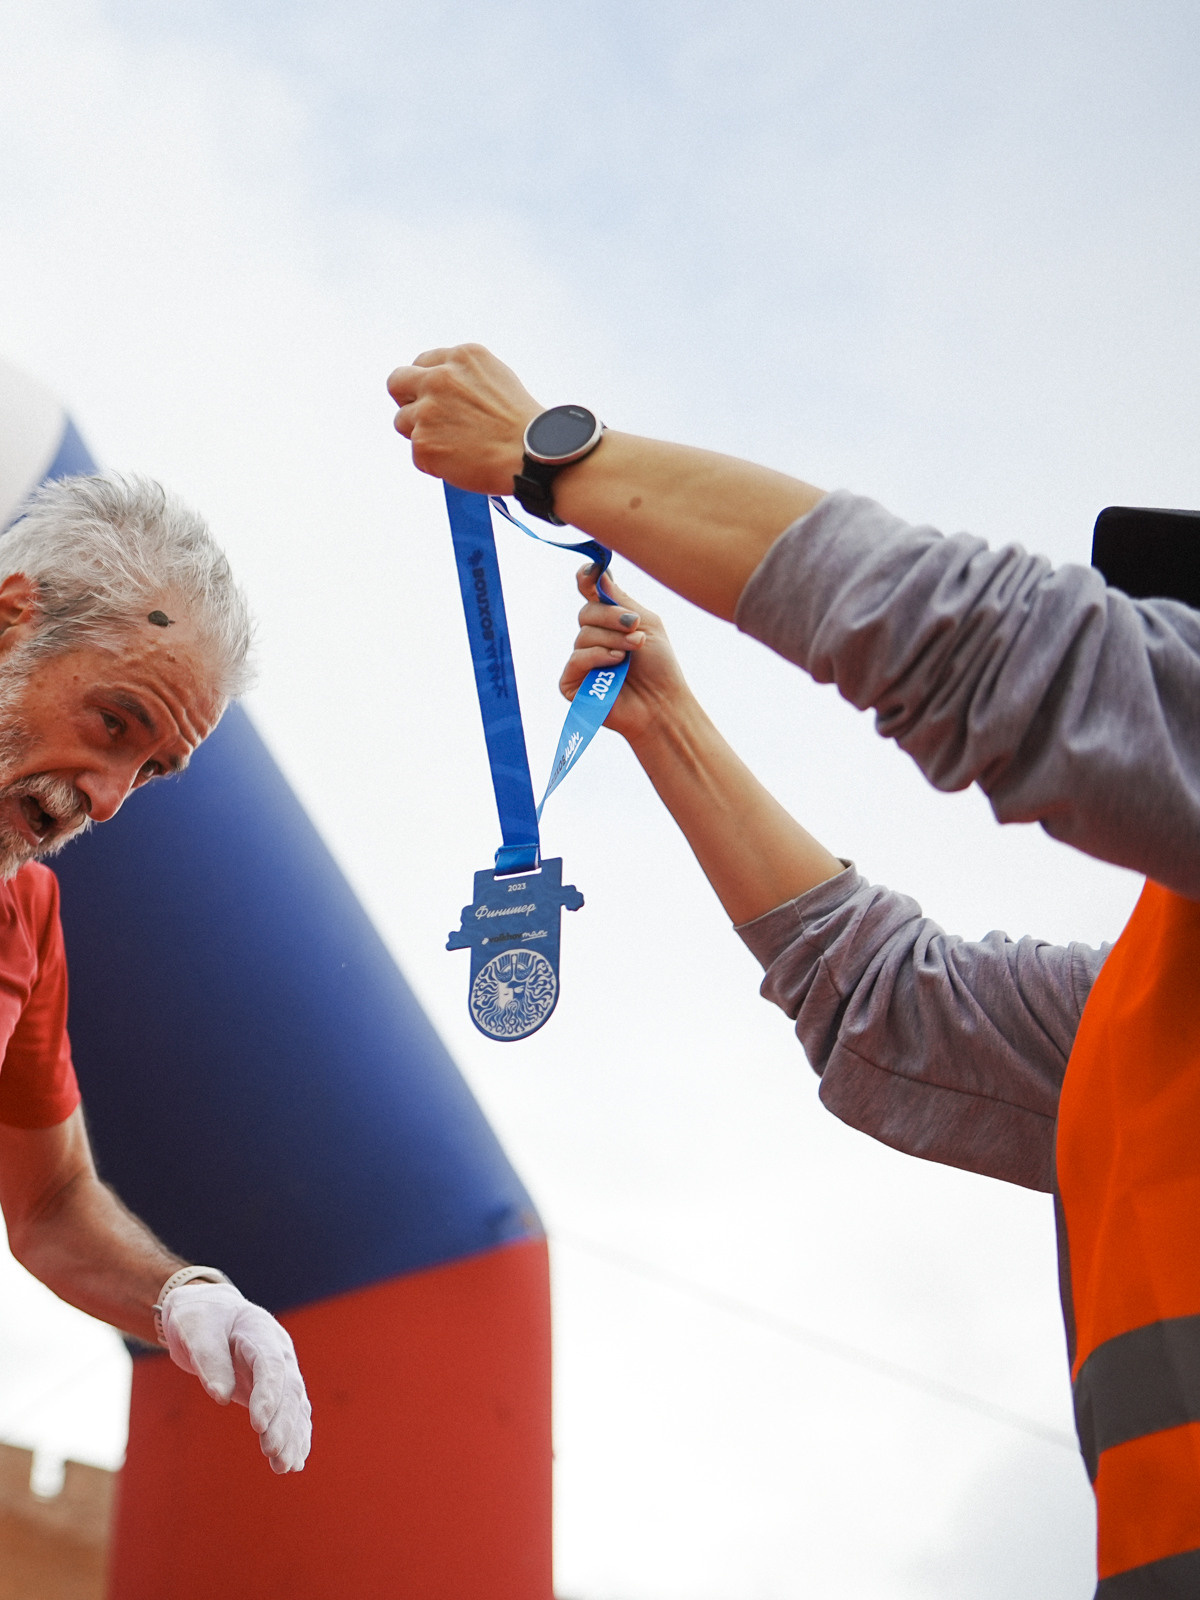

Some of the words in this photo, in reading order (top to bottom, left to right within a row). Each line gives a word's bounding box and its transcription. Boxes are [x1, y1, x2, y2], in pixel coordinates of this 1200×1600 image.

[588, 671, 615, 700] 2023
[507, 882, 527, 892] 2023
[475, 903, 537, 920] Финишер
